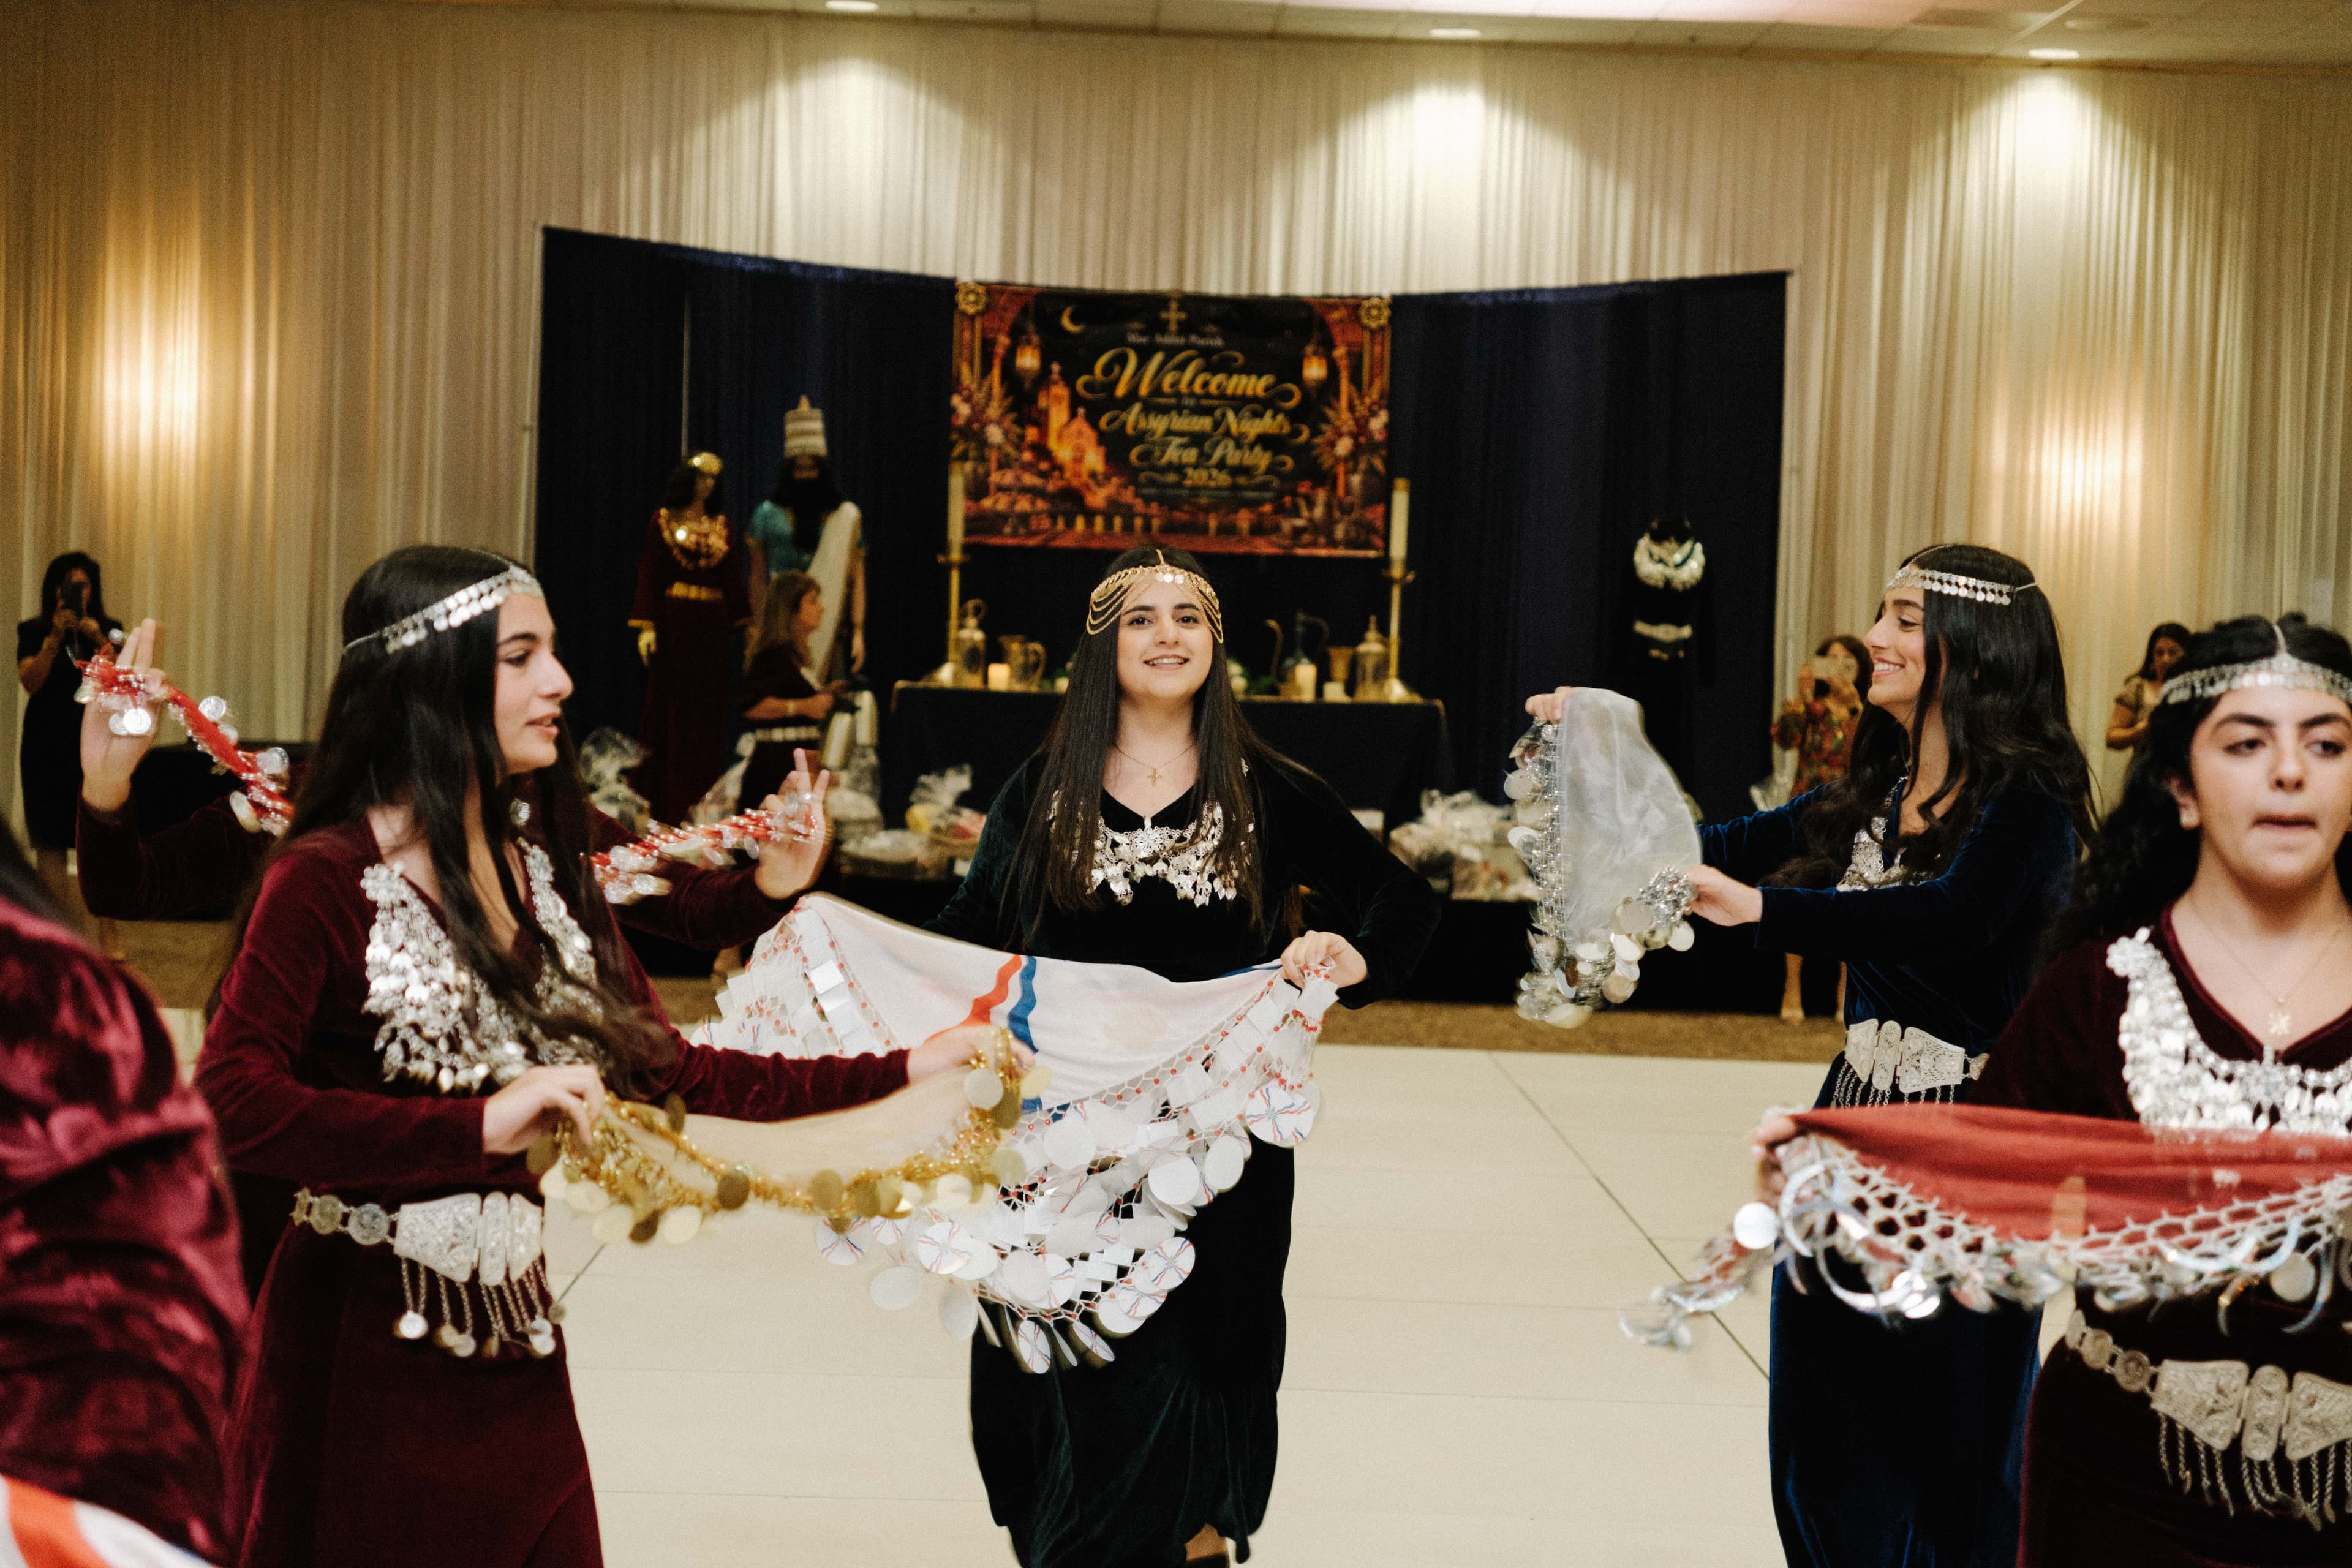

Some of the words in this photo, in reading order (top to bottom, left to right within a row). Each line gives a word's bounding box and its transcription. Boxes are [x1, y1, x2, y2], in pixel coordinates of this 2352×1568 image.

[1076, 347, 1301, 409] Welcome
[1099, 402, 1213, 440] Assyrian
[1129, 435, 1199, 467] Tea
[1202, 435, 1294, 475] Party
[1183, 467, 1232, 488] 2026
